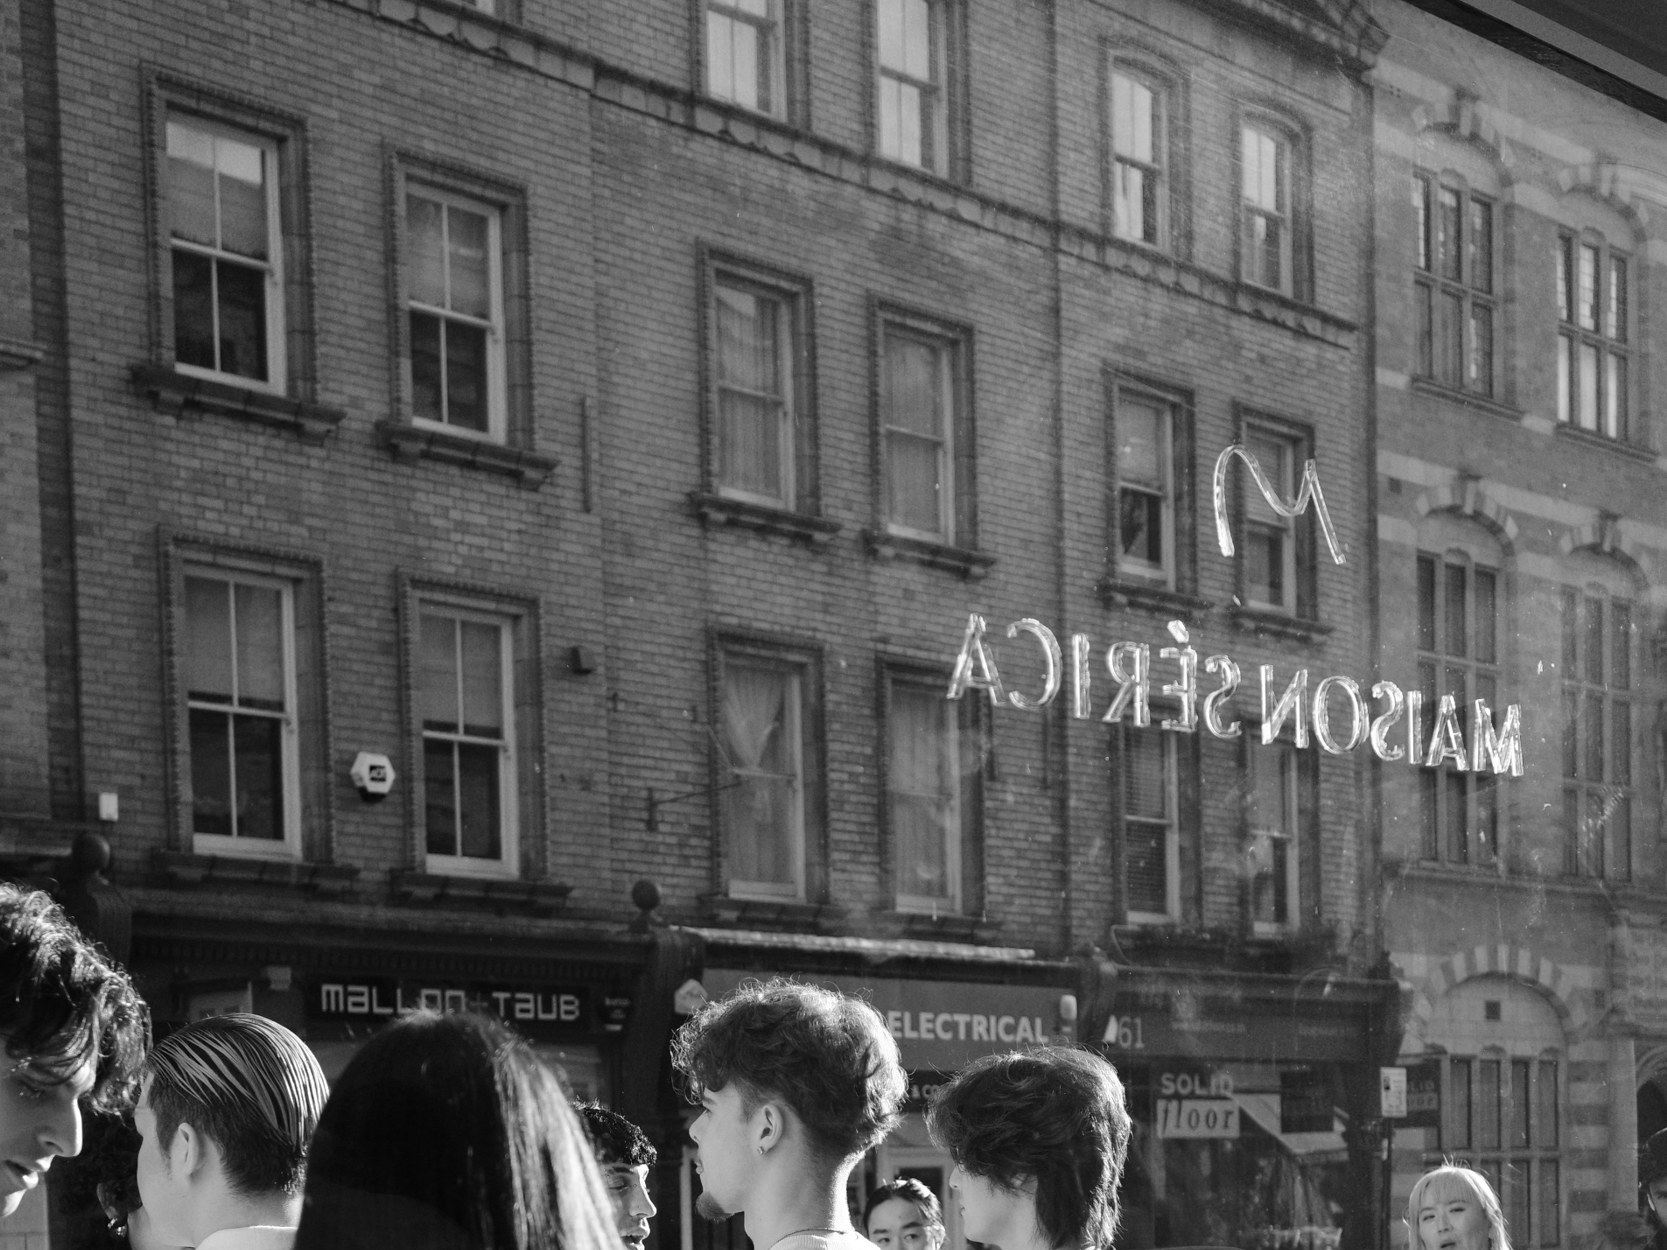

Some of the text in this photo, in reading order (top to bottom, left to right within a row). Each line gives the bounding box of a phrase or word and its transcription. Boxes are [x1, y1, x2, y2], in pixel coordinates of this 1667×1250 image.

[887, 1010, 1049, 1043] ELECTRICAL
[1118, 1015, 1144, 1048] 61
[1161, 1072, 1234, 1096] SOLID
[1163, 1099, 1235, 1134] floor
